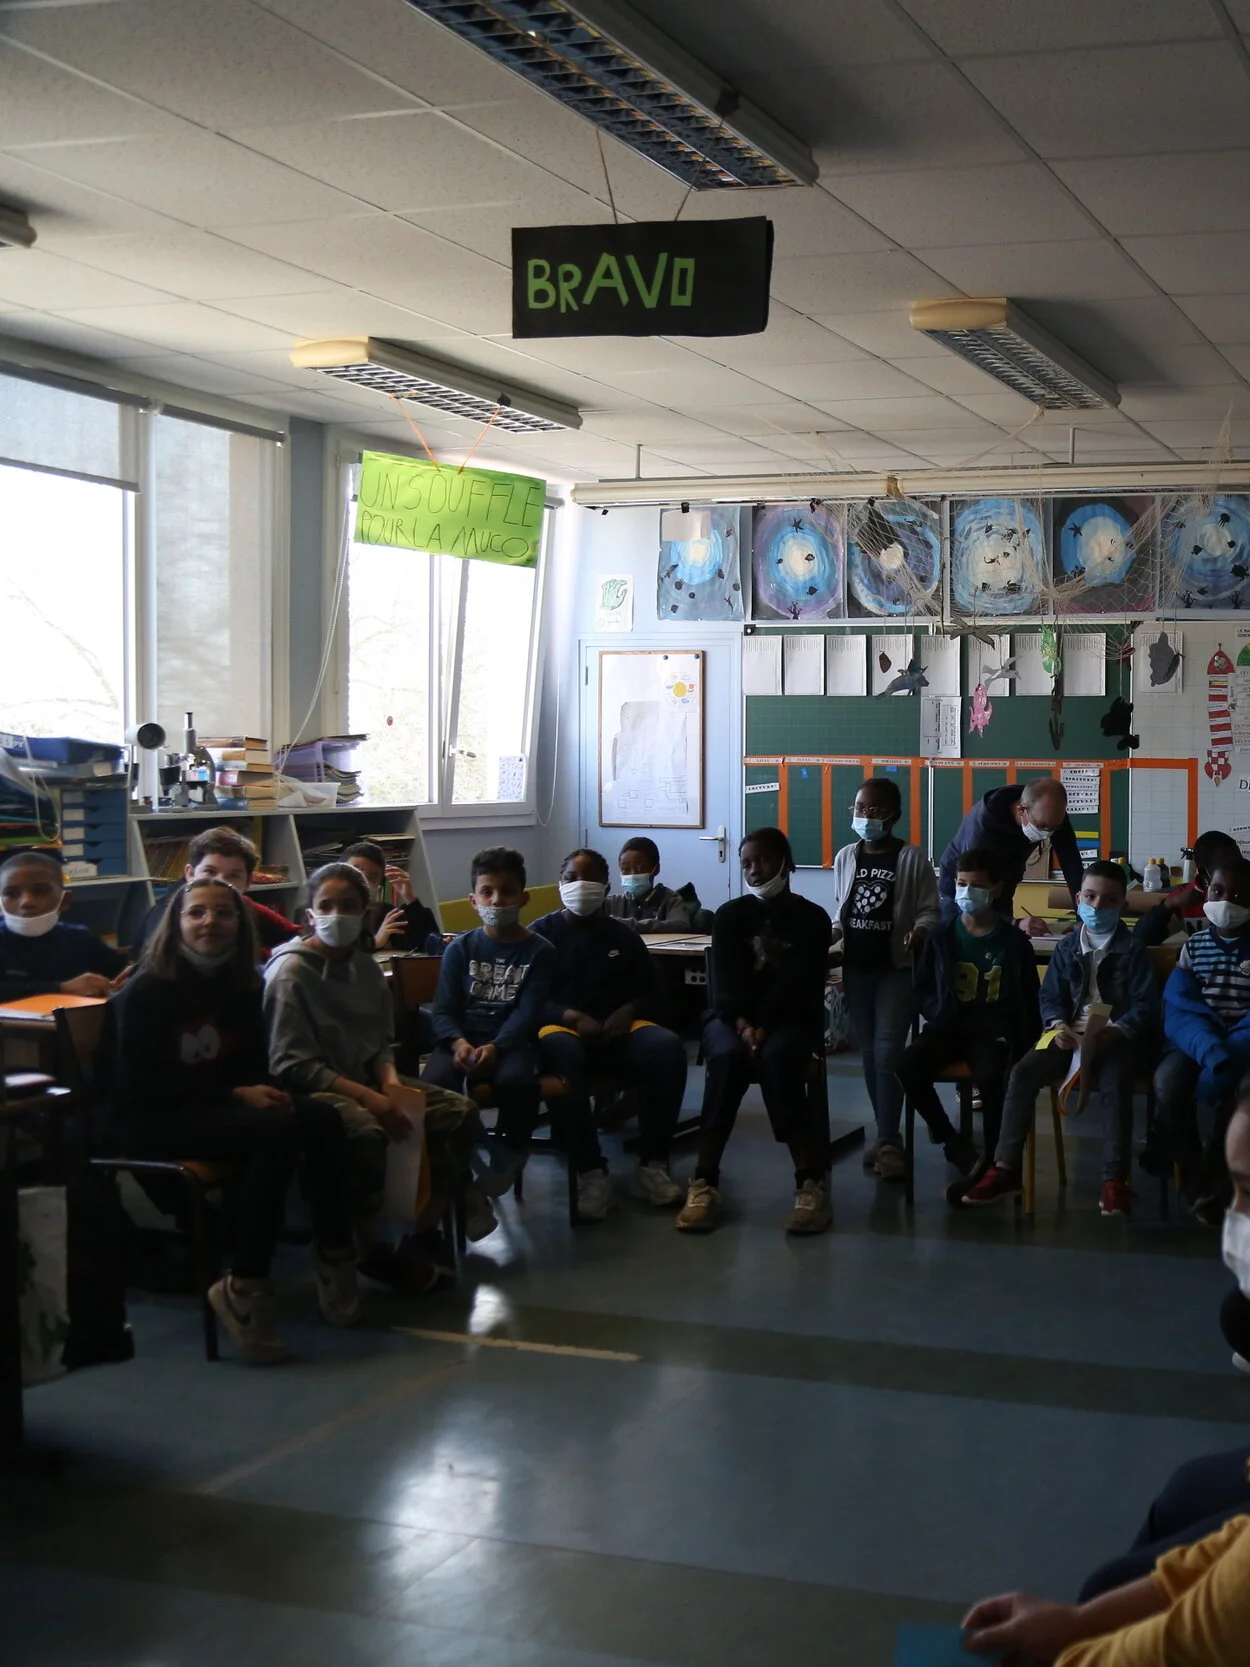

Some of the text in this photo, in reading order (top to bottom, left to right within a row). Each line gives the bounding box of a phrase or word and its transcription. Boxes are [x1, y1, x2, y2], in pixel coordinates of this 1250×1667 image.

[527, 252, 695, 313] BRAVO
[360, 470, 541, 528] UN SOUFFLE
[361, 509, 529, 558] POUR LA MUCO
[849, 917, 892, 931] EAKFAST
[469, 960, 530, 984] GREAT
[956, 961, 1002, 1004] 91
